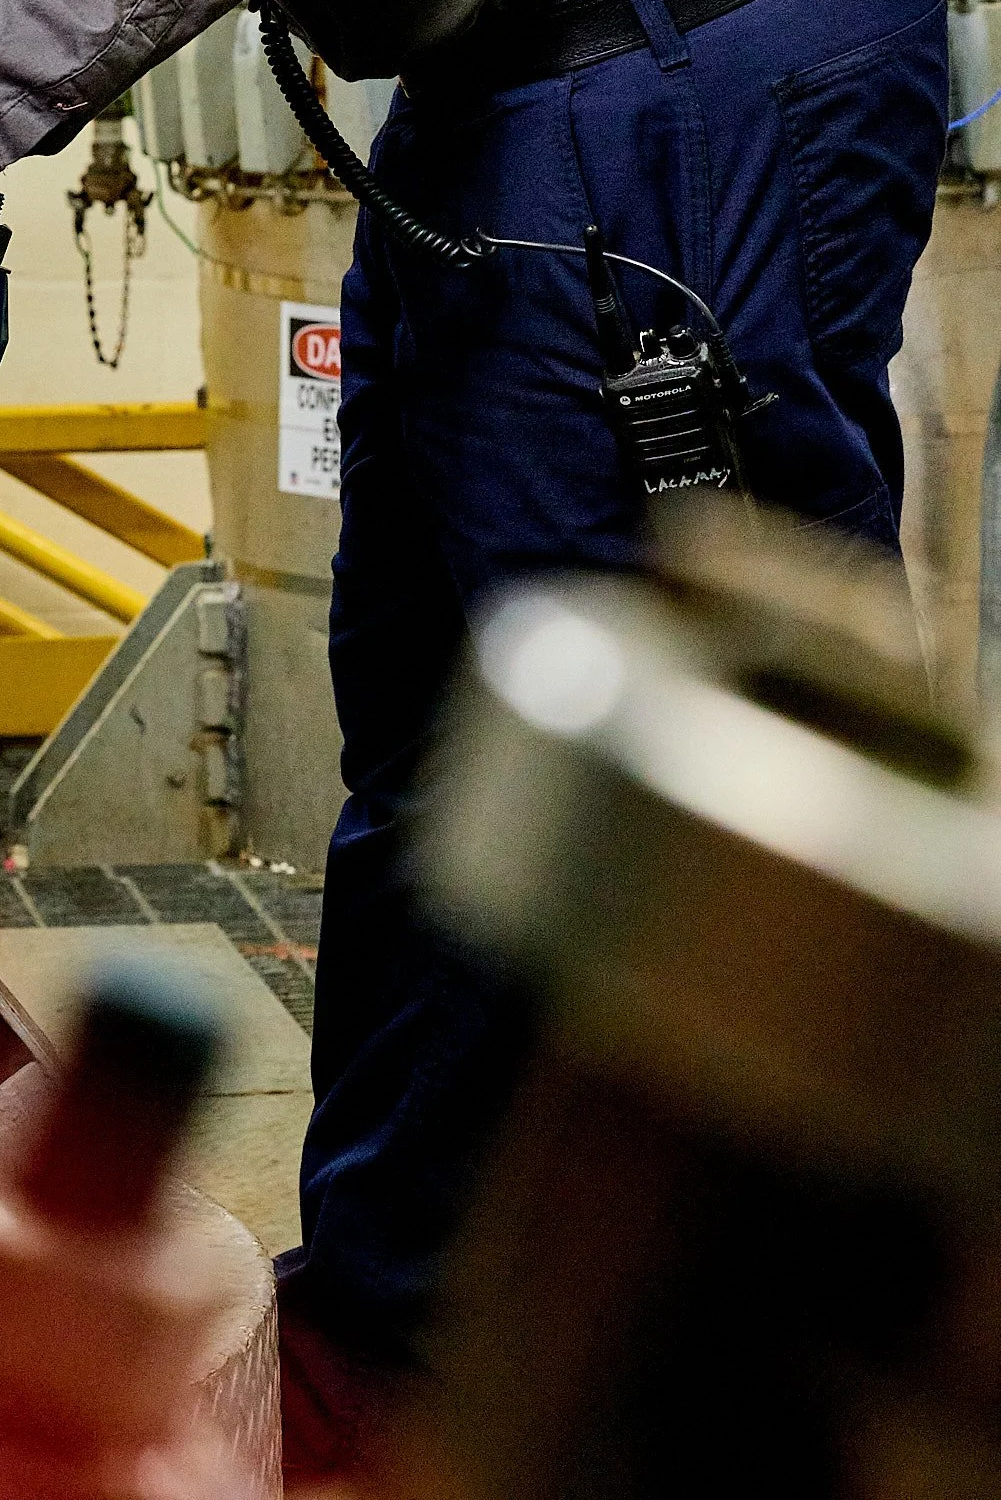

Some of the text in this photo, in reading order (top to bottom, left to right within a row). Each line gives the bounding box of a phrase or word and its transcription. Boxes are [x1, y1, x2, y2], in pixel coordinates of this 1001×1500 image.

[306, 333, 341, 368] DA
[298, 383, 341, 411] CONF
[634, 384, 692, 402] MOTOROLA
[311, 445, 341, 472] PER
